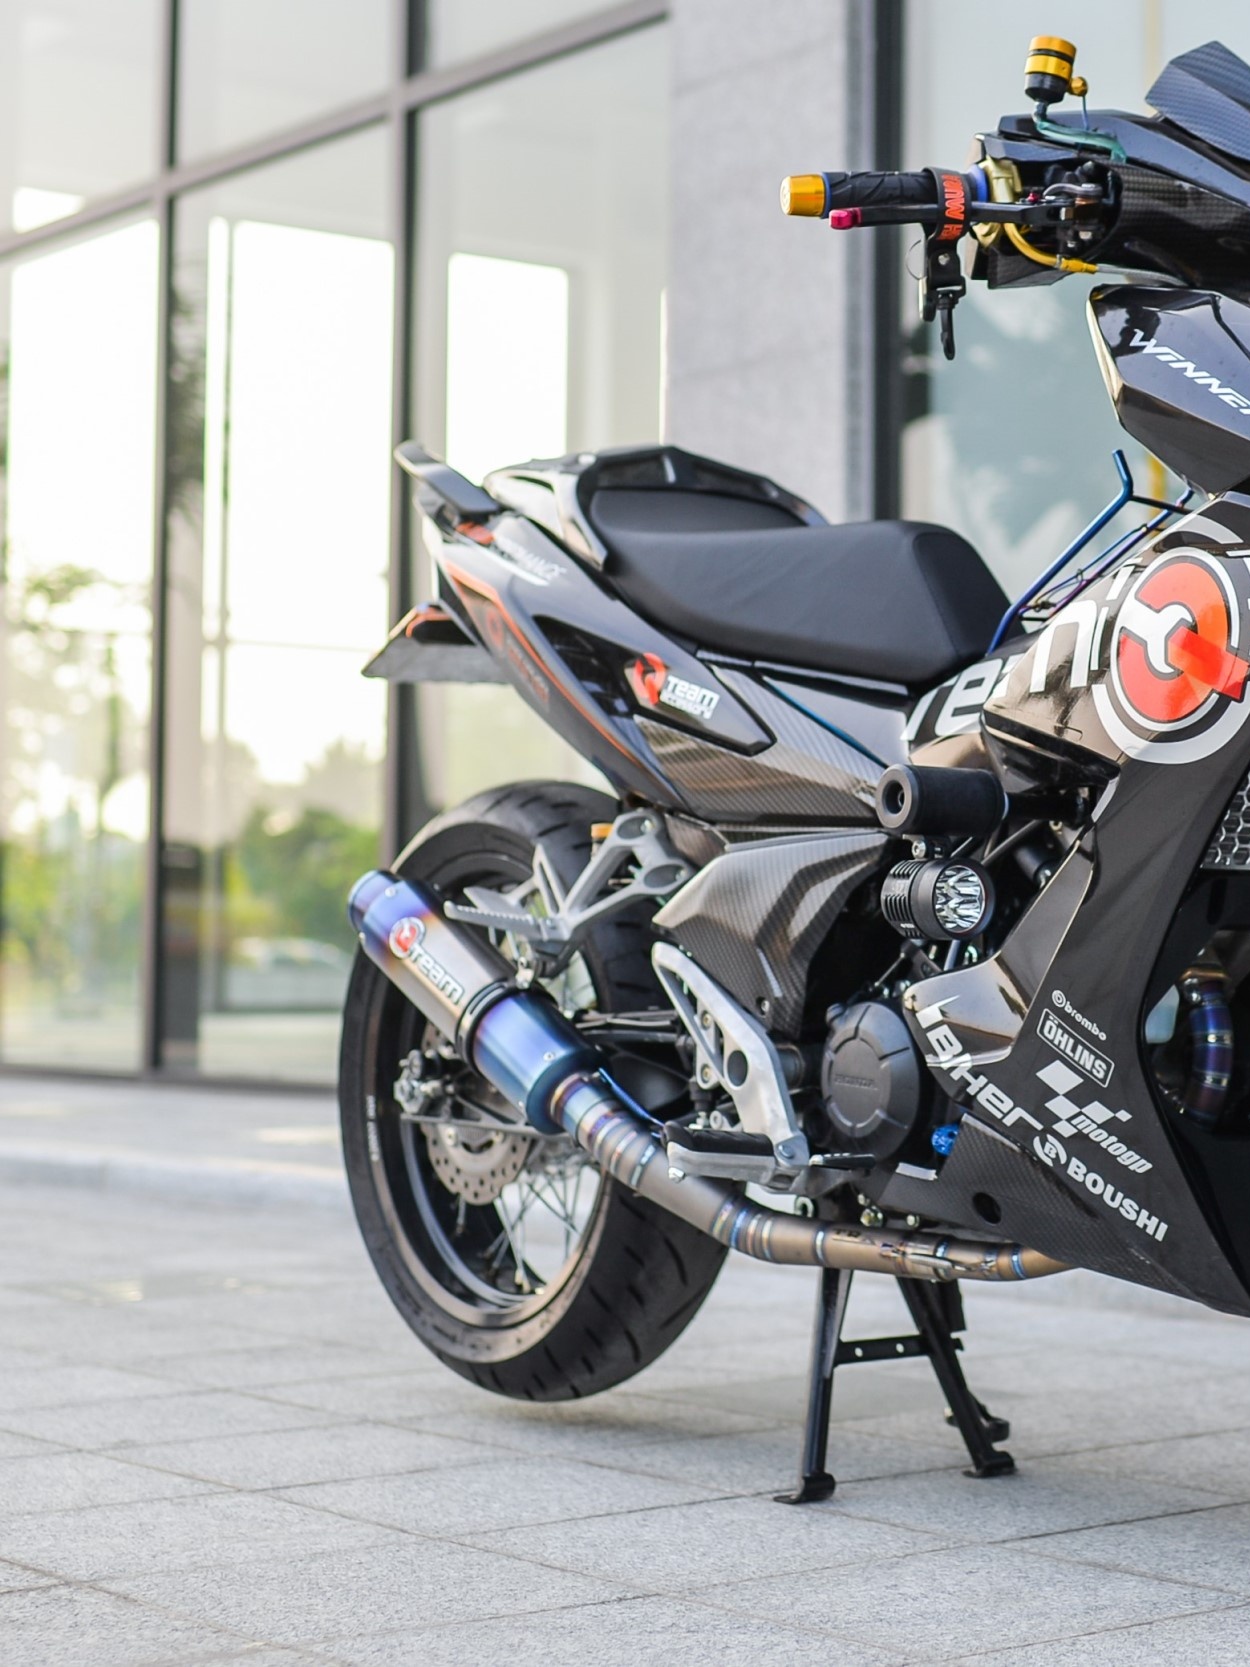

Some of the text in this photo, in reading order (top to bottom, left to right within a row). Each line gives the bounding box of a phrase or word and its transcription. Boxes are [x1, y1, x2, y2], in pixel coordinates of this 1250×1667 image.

[1043, 1015, 1107, 1080] ÖHLINS
[1063, 1000, 1107, 1041] brembo
[1070, 1114, 1153, 1174] motogp
[1066, 1156, 1169, 1242] BOUSHI
